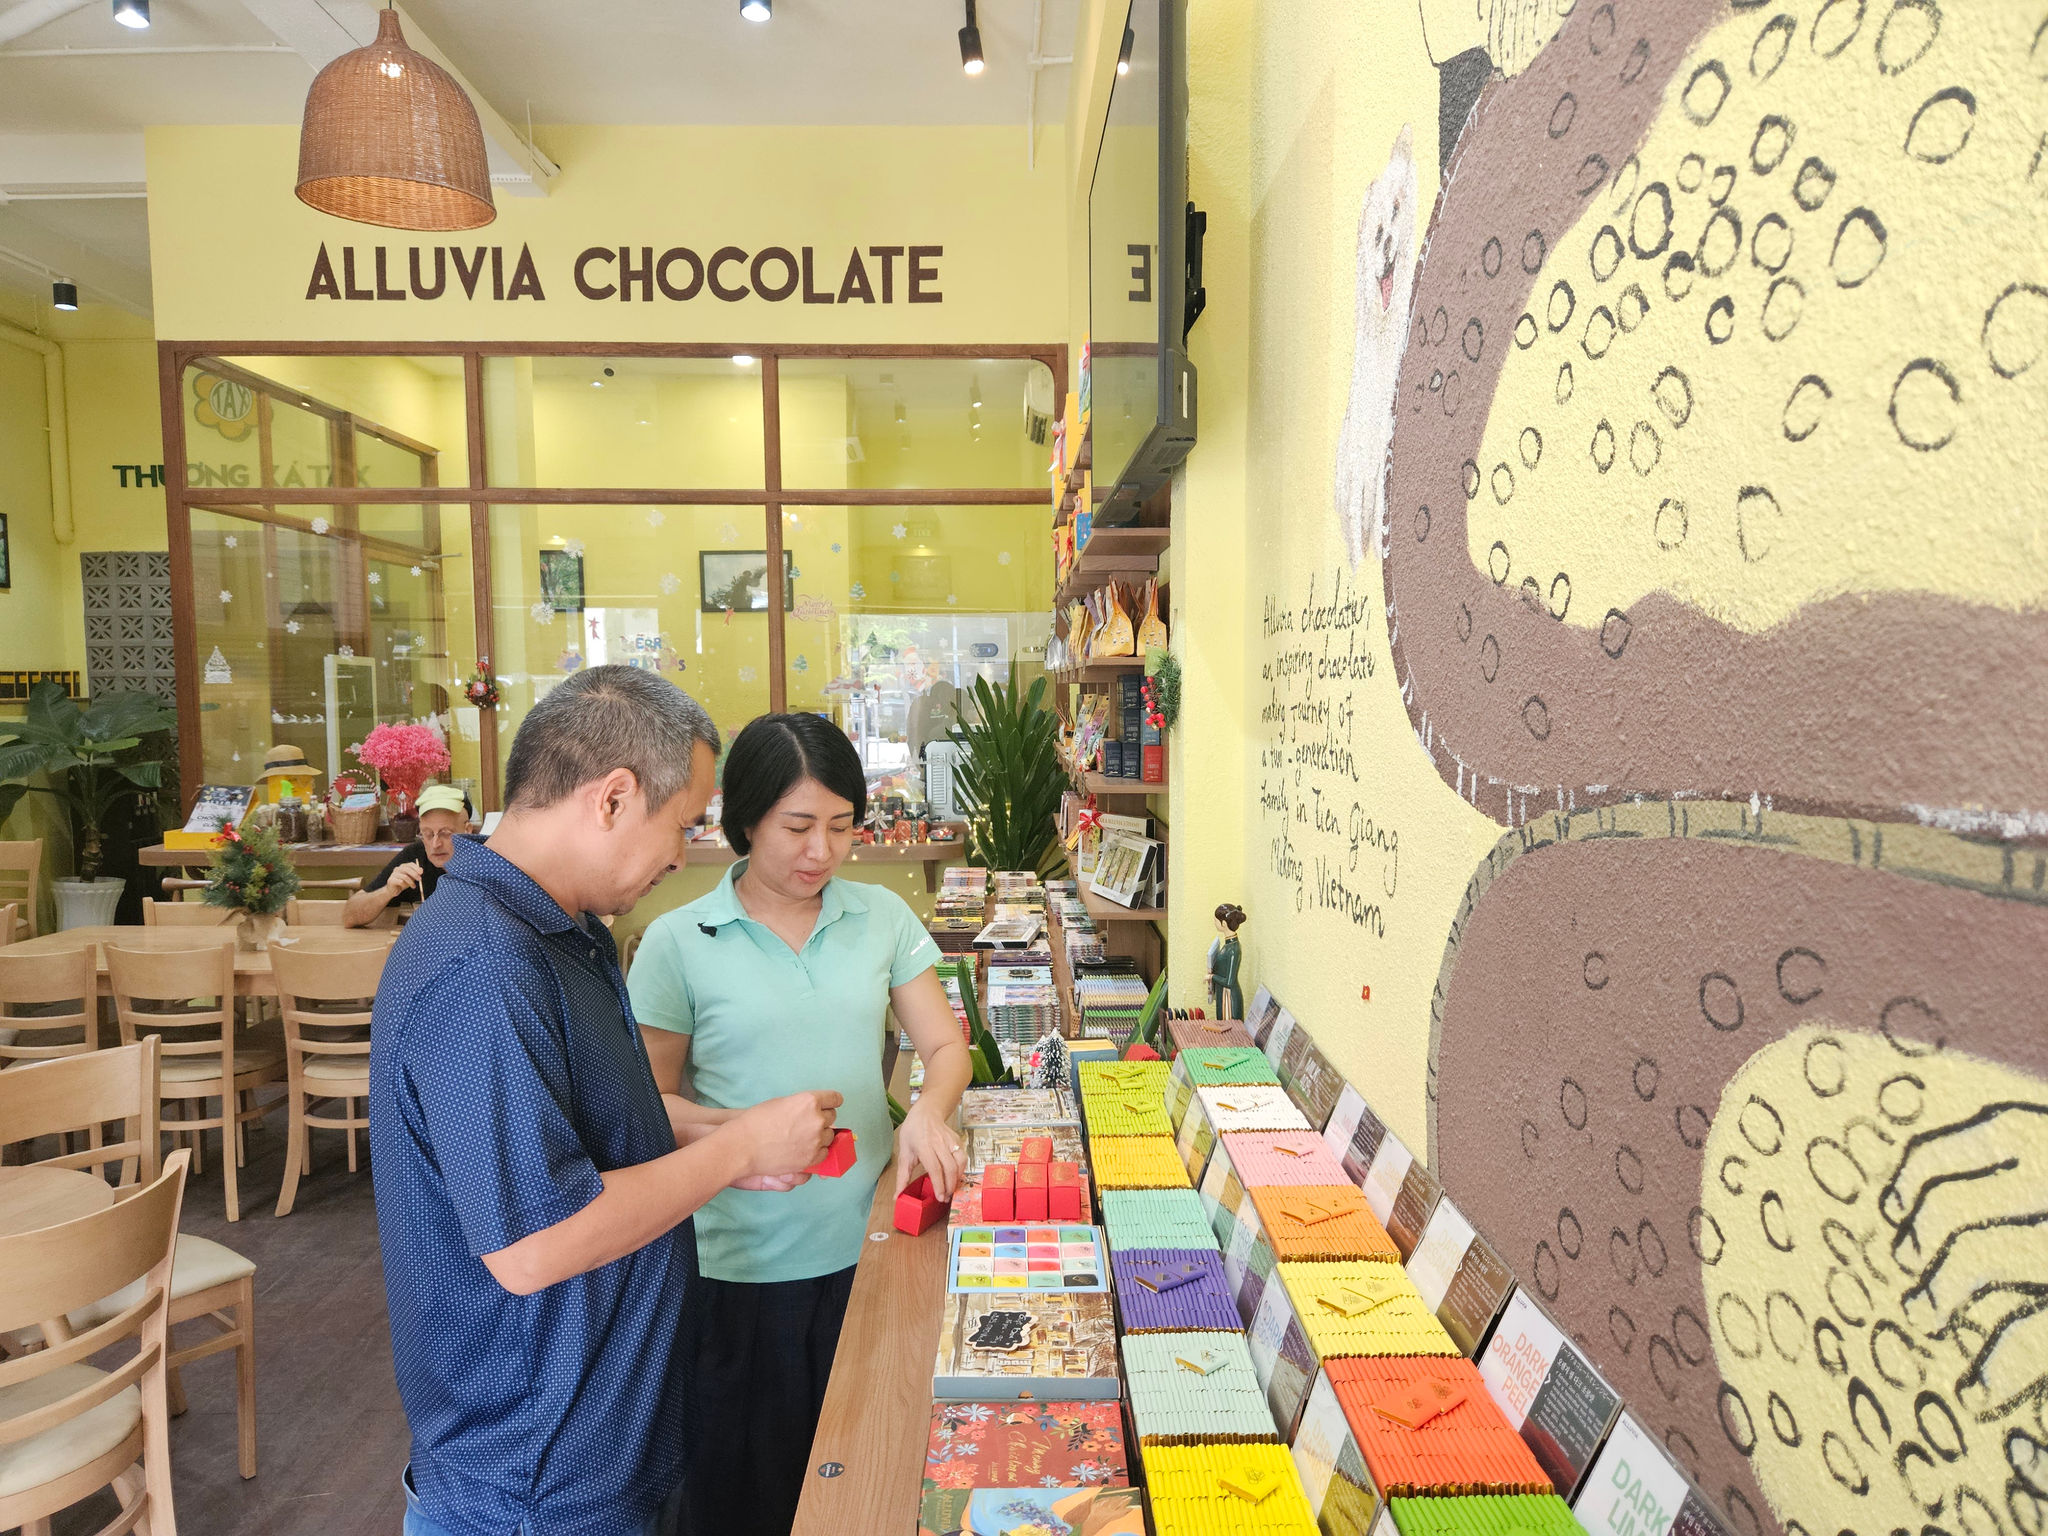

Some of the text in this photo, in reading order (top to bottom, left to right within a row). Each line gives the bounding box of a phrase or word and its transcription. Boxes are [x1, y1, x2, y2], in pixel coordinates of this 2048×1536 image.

[305, 241, 944, 304] ALLUVIA CHOCOLATE
[212, 382, 250, 419] TAX
[1263, 594, 1293, 639] Alluvia
[1262, 629, 1376, 700] an inspiring chocolate
[1261, 686, 1286, 745] making
[1339, 690, 1354, 744] of
[1261, 750, 1270, 768] a
[1260, 777, 1289, 841] family
[1296, 794, 1308, 823] in
[1349, 801, 1399, 900] Giang
[1315, 854, 1386, 939] Vietnam
[1492, 1334, 1540, 1400] ORANGE
[1515, 1332, 1550, 1380] DARK
[1501, 1375, 1528, 1418] PEEL
[1007, 1430, 1029, 1484] Christmas
[1023, 1435, 1051, 1475] Merry
[1611, 1458, 1673, 1536] DARK
